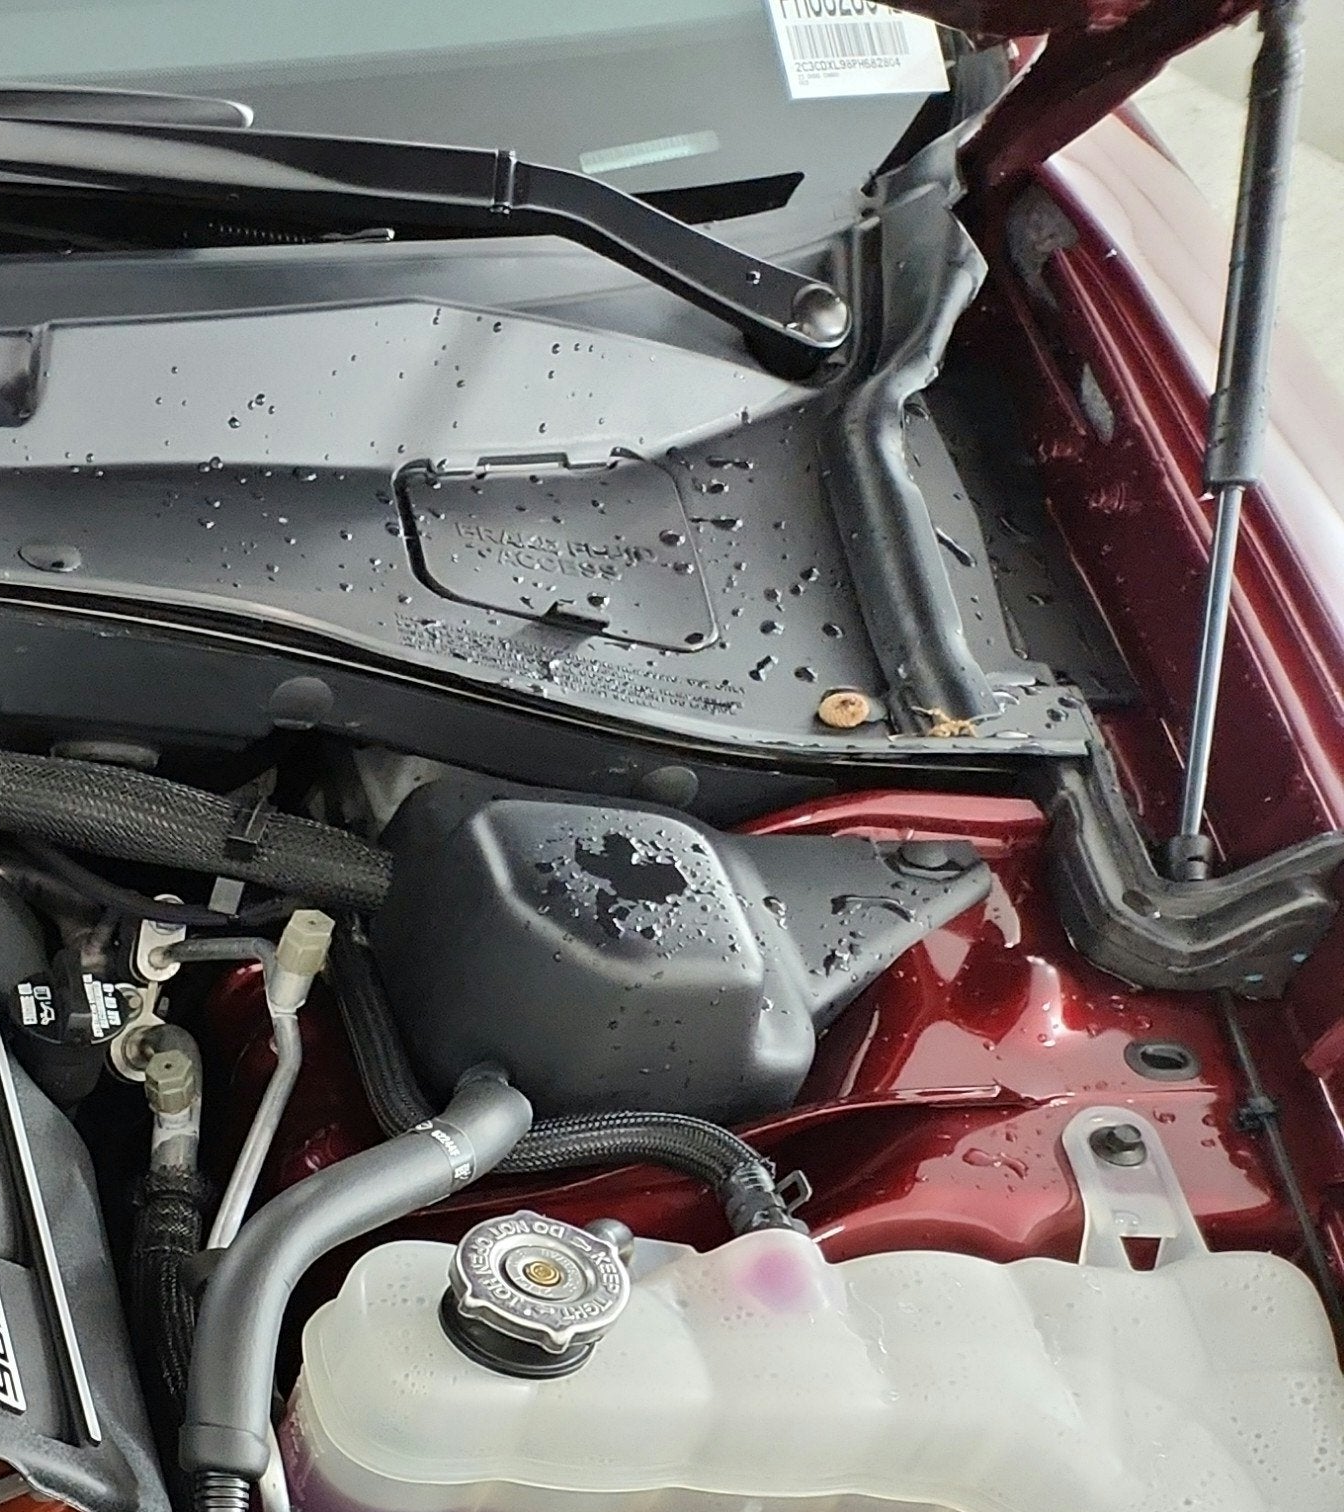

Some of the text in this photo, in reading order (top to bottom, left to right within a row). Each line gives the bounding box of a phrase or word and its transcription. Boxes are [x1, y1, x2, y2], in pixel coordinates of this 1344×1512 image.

[499, 550, 618, 580] ACCESS
[489, 1219, 530, 1241] NOT
[533, 1222, 565, 1239] DO
[562, 1250, 621, 1321] KEEP TIGHT
